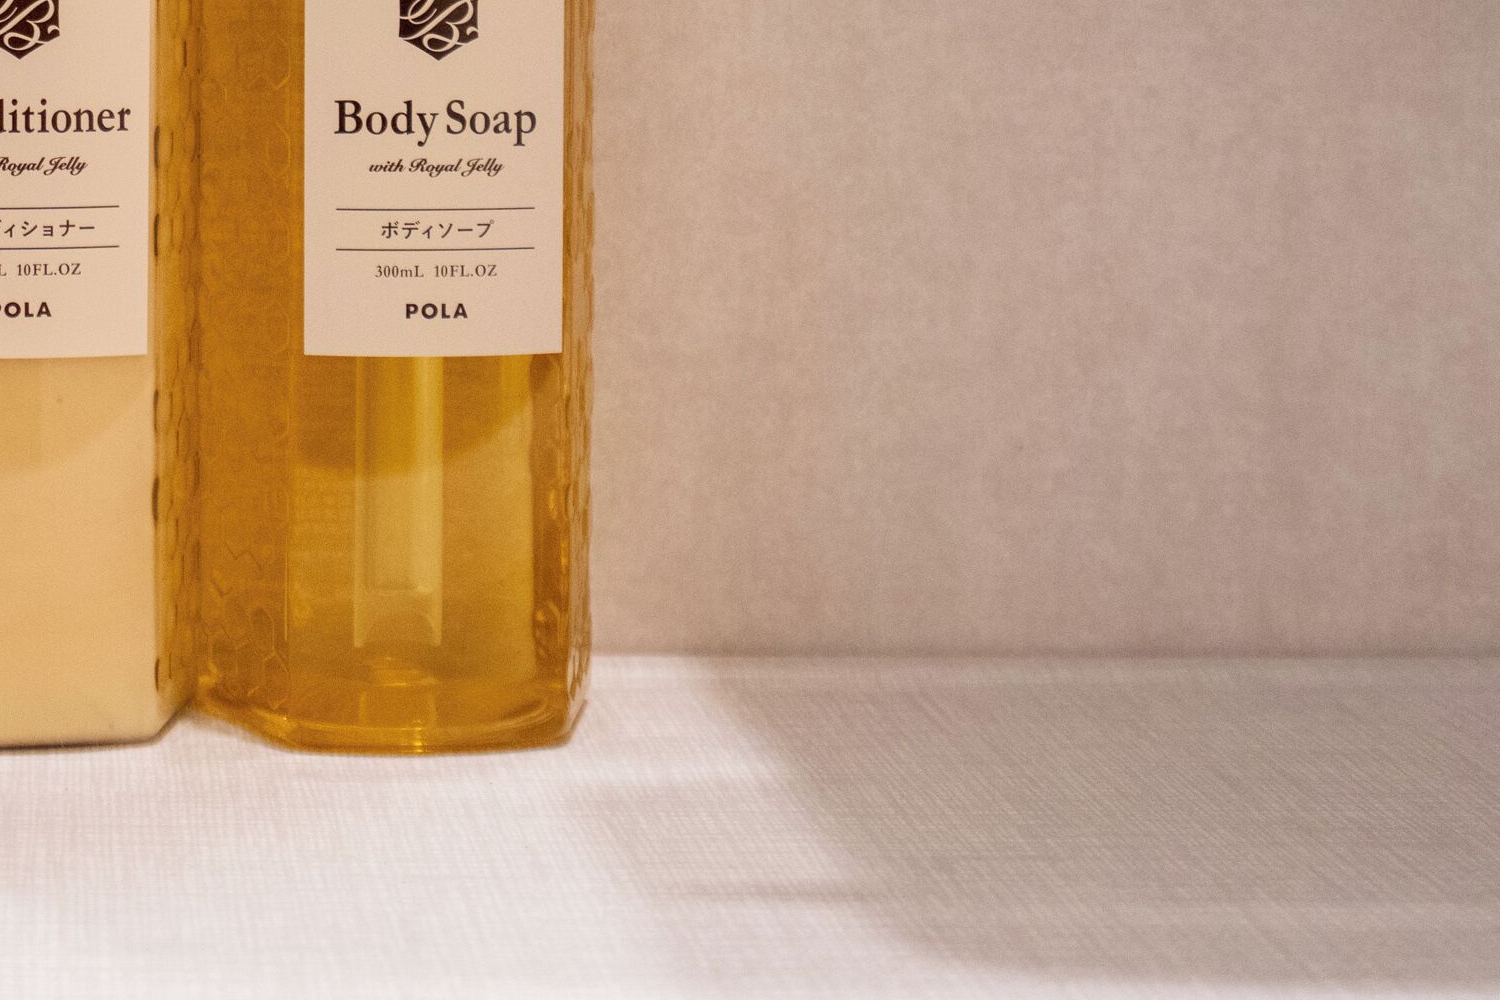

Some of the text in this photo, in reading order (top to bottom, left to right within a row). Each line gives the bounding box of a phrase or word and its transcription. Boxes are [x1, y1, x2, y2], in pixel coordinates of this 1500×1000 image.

[333, 99, 537, 148] Body Soap
[43, 156, 87, 176] Jelly
[368, 157, 503, 178] with Royal Jelly
[381, 219, 494, 240] ボディソープ
[17, 262, 82, 276] 10FL.OZ
[375, 264, 497, 278] 300mL 10FL.OZ
[405, 302, 468, 320] POLA
